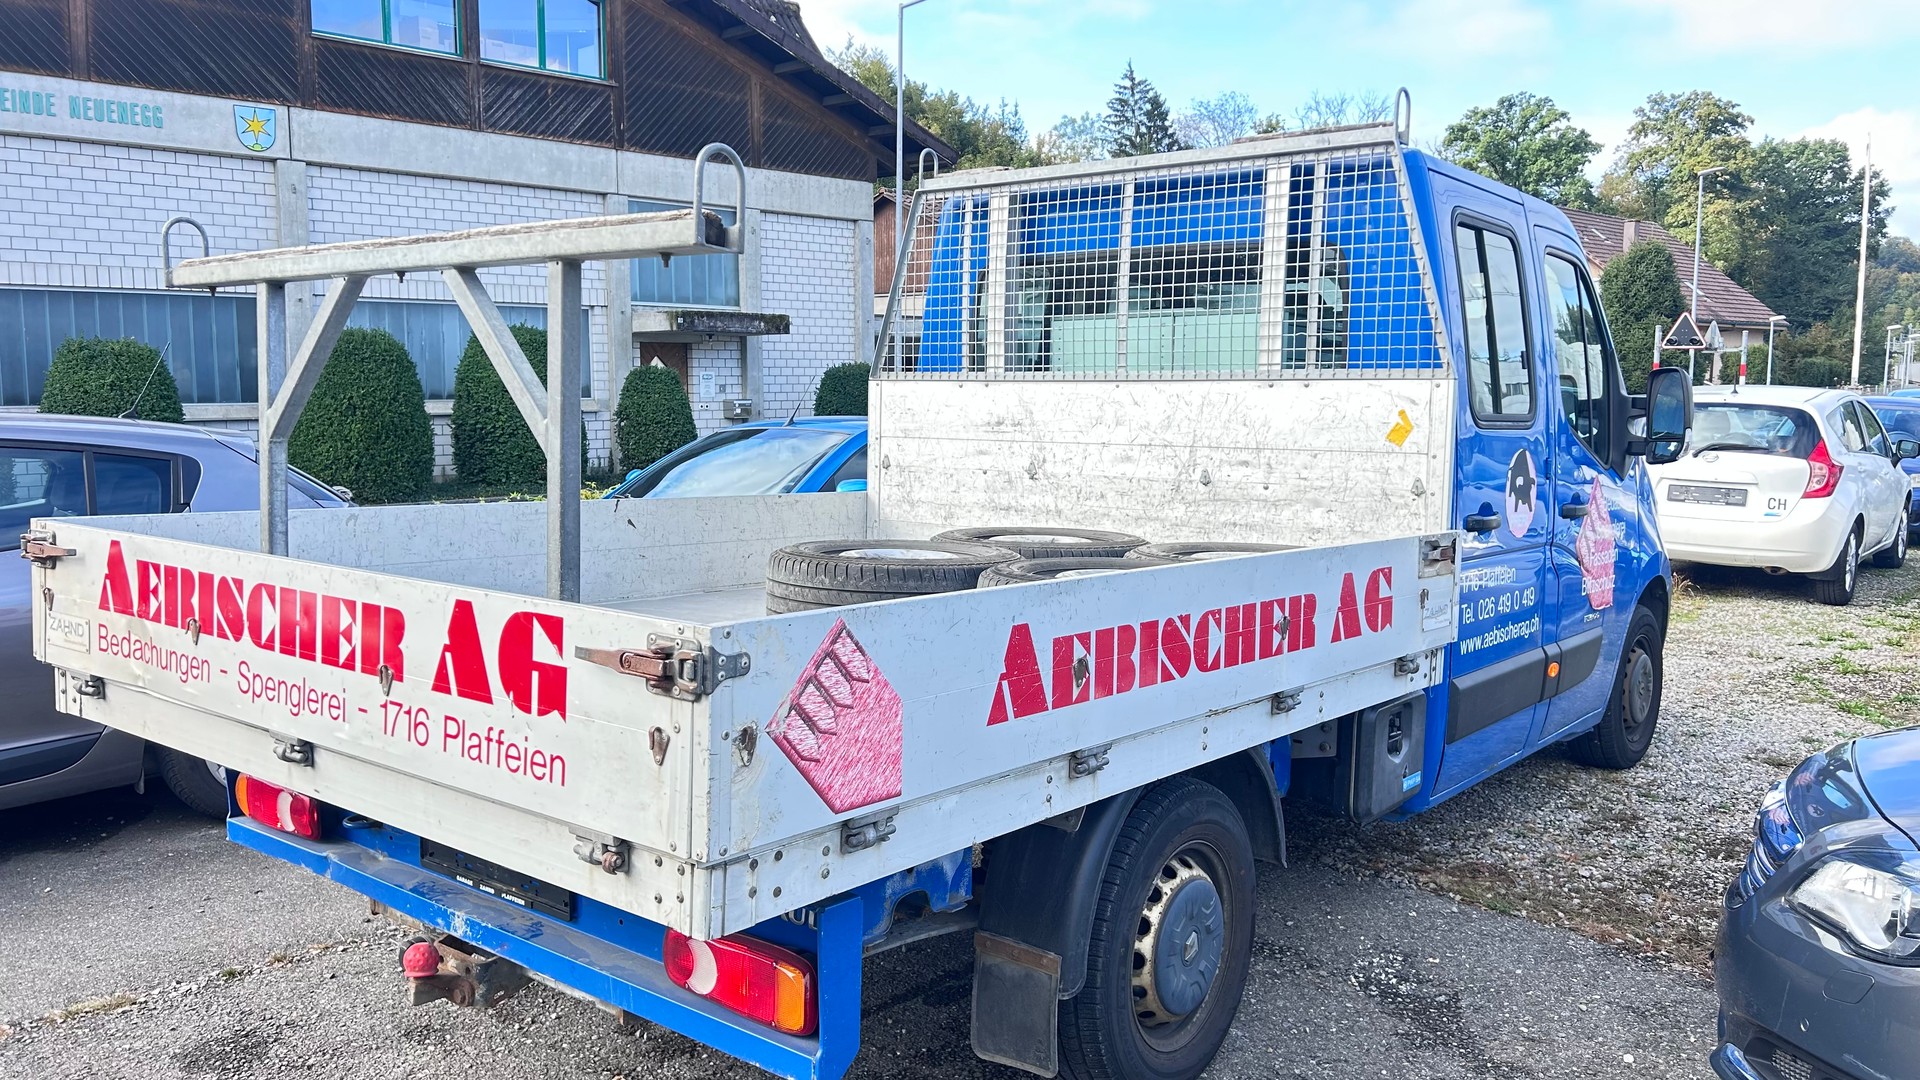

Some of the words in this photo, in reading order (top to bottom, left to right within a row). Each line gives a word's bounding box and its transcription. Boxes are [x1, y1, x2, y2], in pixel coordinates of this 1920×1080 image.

[68, 95, 164, 129] NEUENEGG
[1767, 497, 1787, 511] CH
[1461, 602, 1475, 625] Tel.
[1478, 596, 1496, 620] 026
[1497, 592, 1512, 614] 419
[1513, 590, 1520, 610] 0
[1522, 586, 1535, 607] 419
[98, 539, 405, 683] AEBISCHER
[431, 598, 568, 723] AG
[986, 592, 1318, 727] AEBISCHER
[1331, 566, 1393, 644] AG
[1460, 612, 1540, 656] www.aebischerag.ch
[98, 623, 211, 684] Bedachungen
[237, 660, 346, 722] Spenglerei
[379, 699, 430, 747] 1716
[443, 714, 566, 787] Plaffeien
